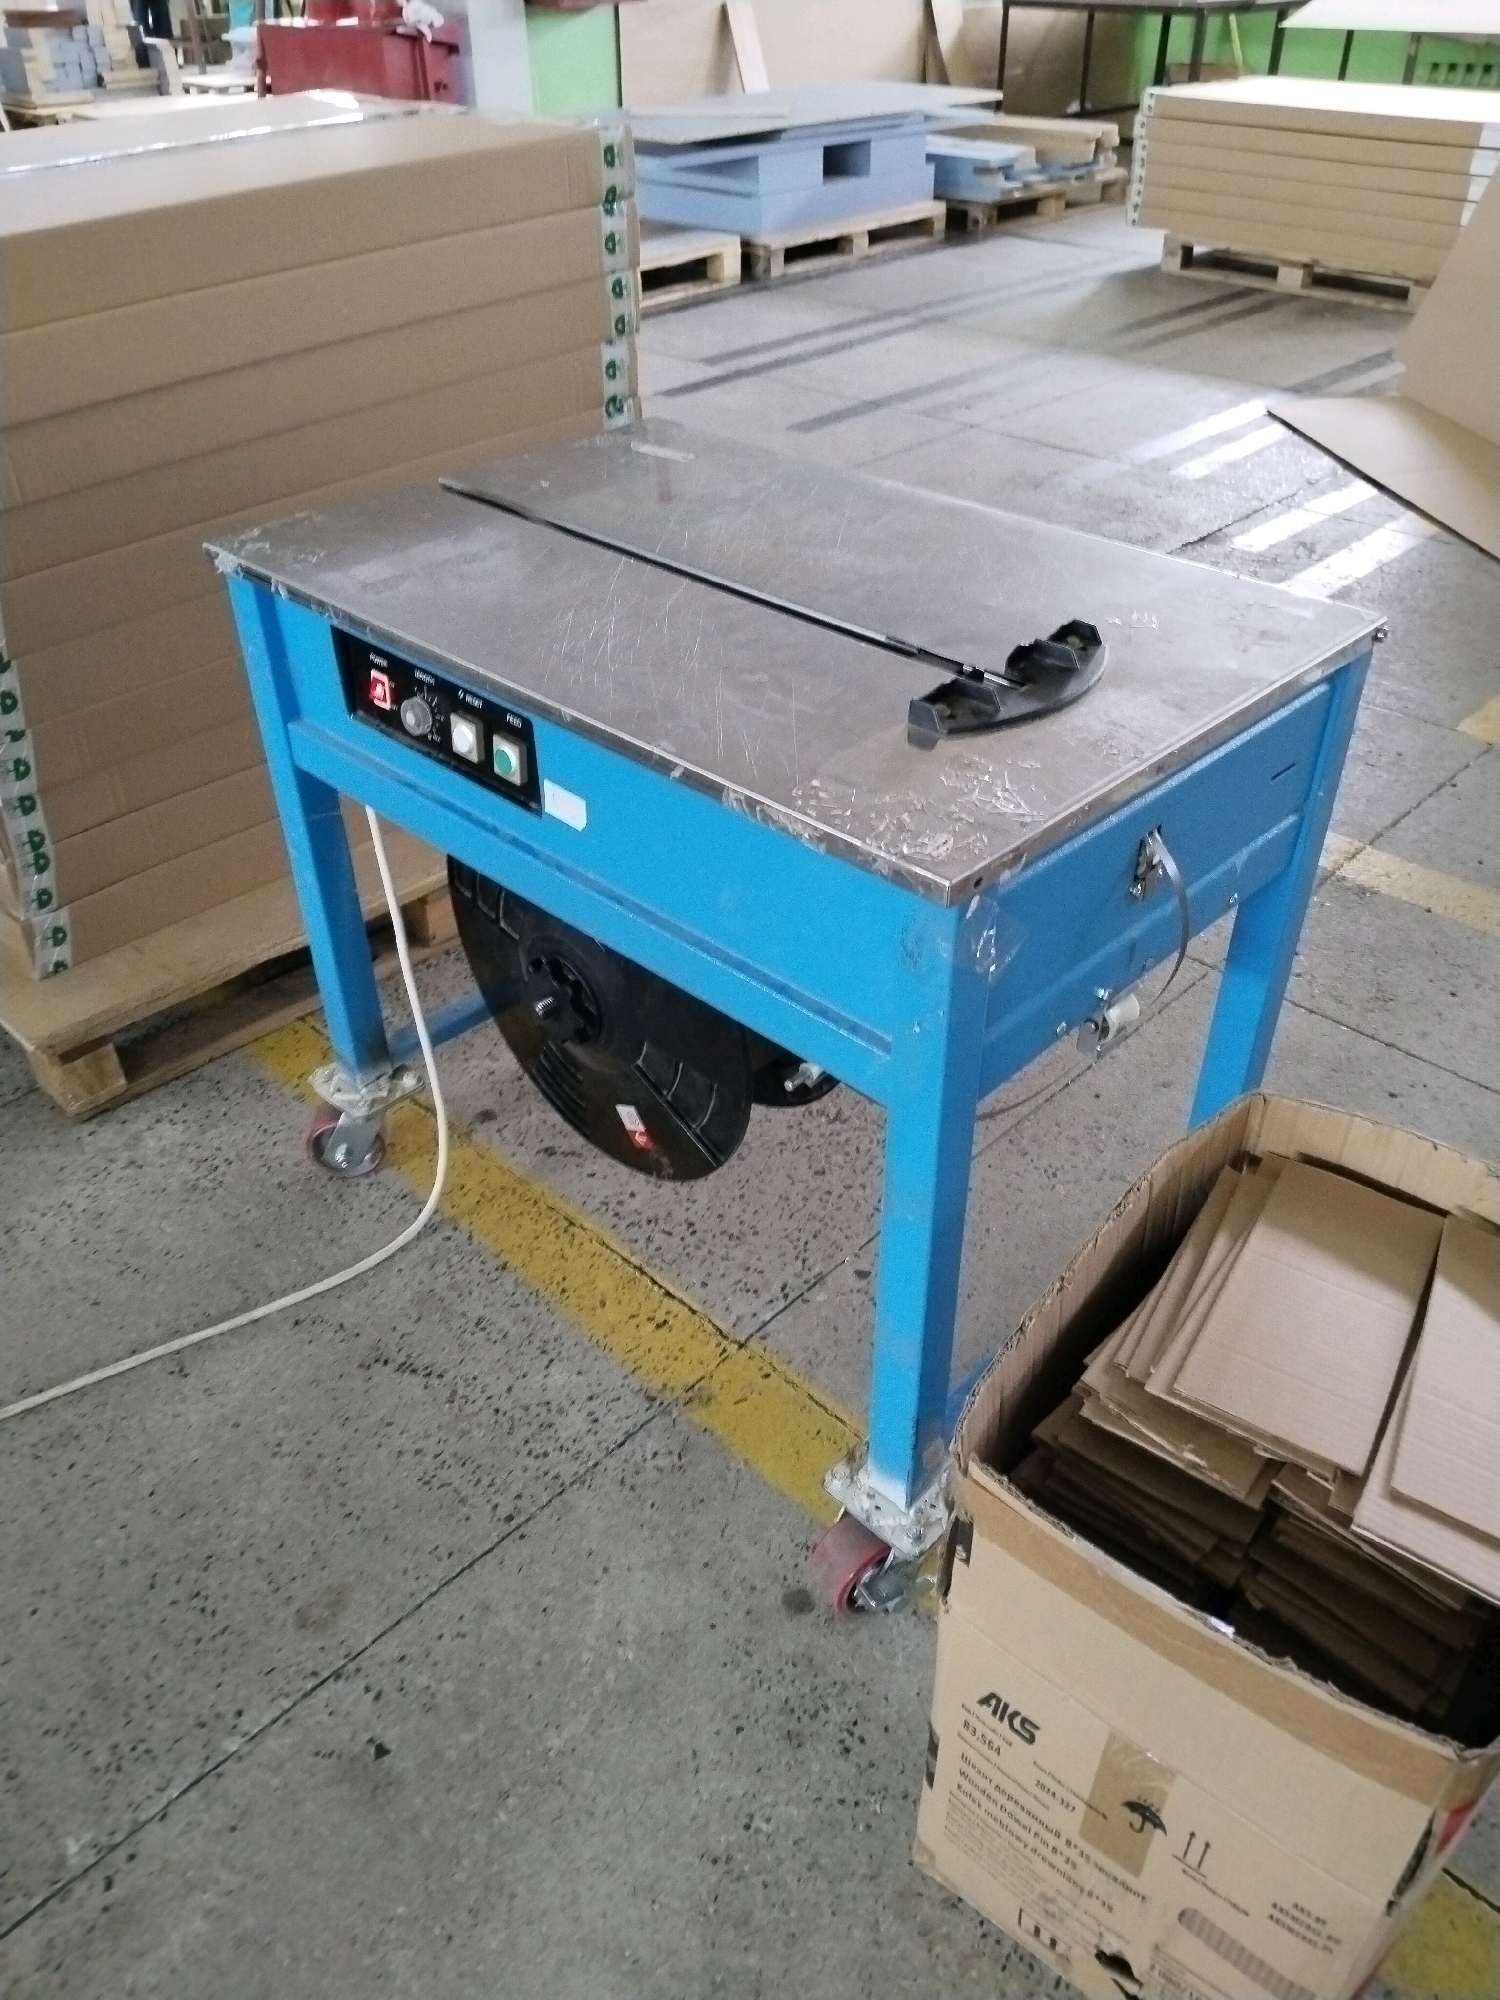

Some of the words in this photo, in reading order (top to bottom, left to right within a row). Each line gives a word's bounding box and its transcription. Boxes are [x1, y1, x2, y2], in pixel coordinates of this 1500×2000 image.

[369, 652, 388, 668] POWER
[506, 712, 522, 729] FEED
[976, 1691, 1041, 1746] AKS
[959, 1768, 998, 1807] Wooden
[1000, 1804, 1032, 1835] Dowel
[1033, 1831, 1049, 1850] Pin
